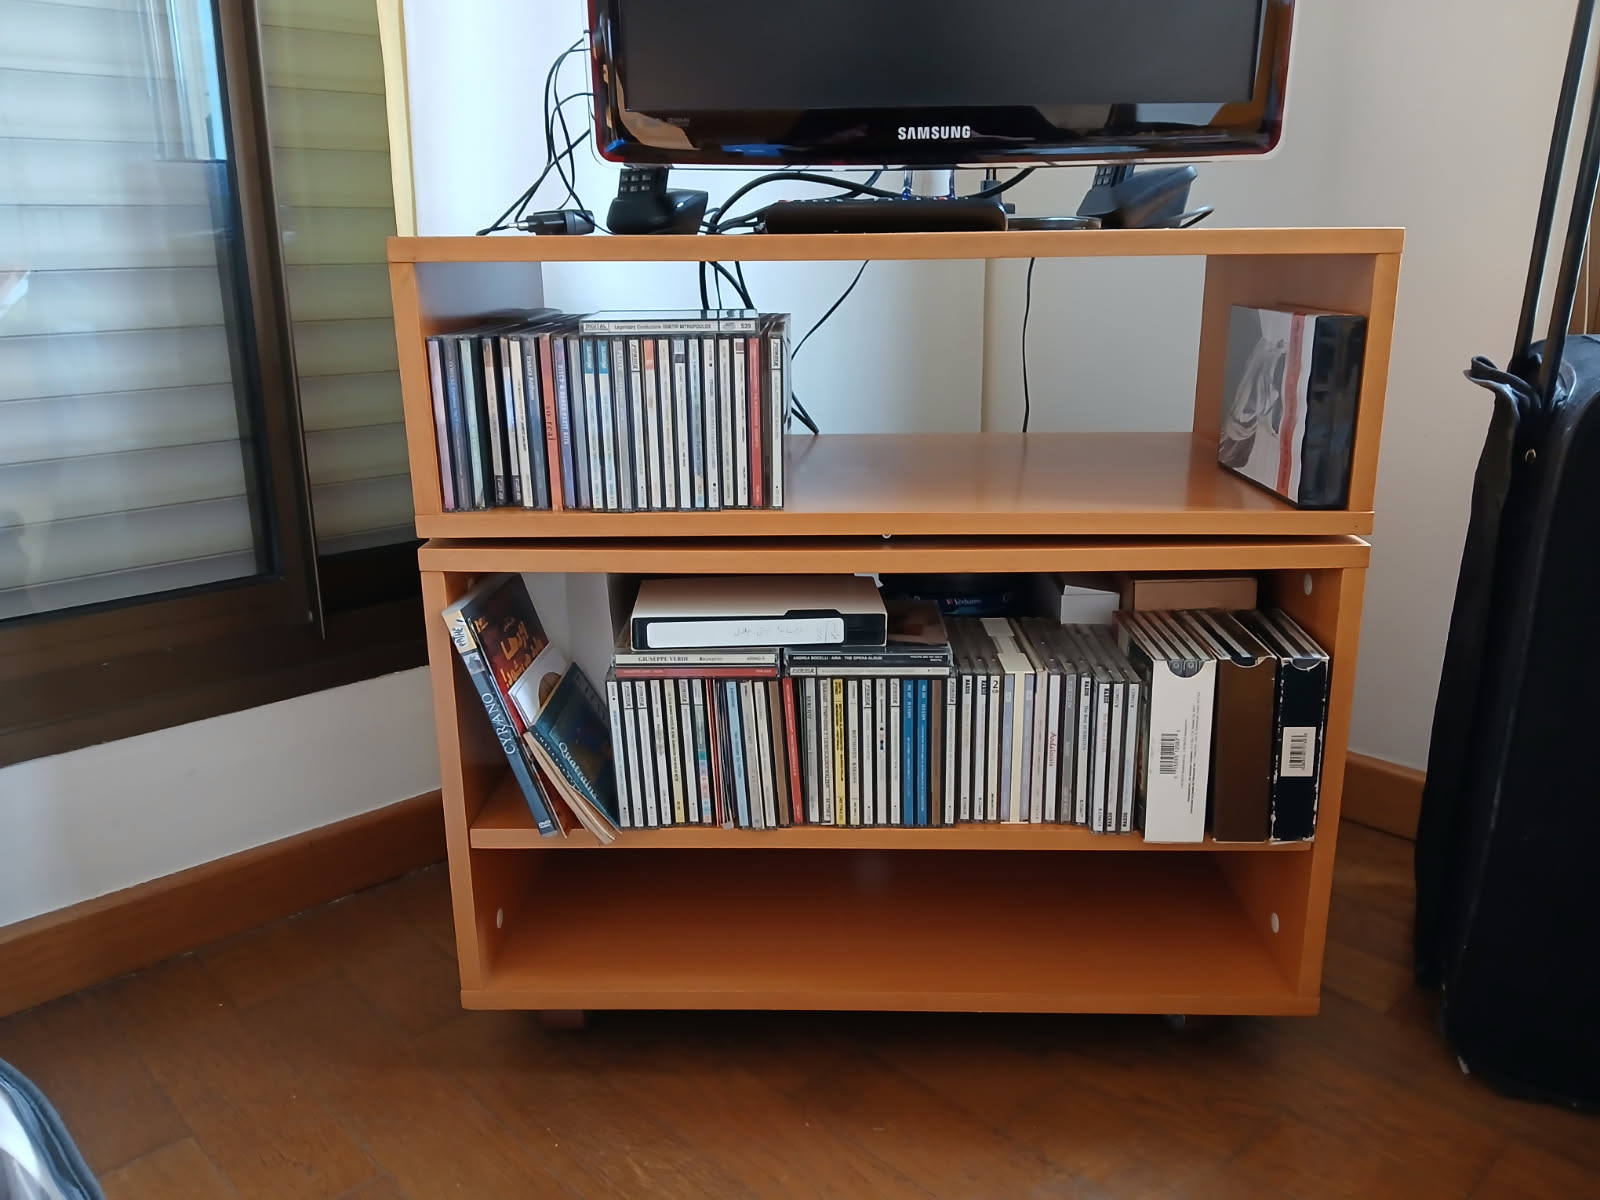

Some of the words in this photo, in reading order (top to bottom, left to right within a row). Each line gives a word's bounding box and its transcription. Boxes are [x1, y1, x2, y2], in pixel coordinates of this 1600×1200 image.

[897, 125, 971, 140] SAMSUNG
[544, 405, 554, 417] so
[546, 421, 557, 441] real
[991, 679, 999, 689] 2
[480, 691, 516, 755] CYRANO
[558, 741, 600, 800] Quatrains
